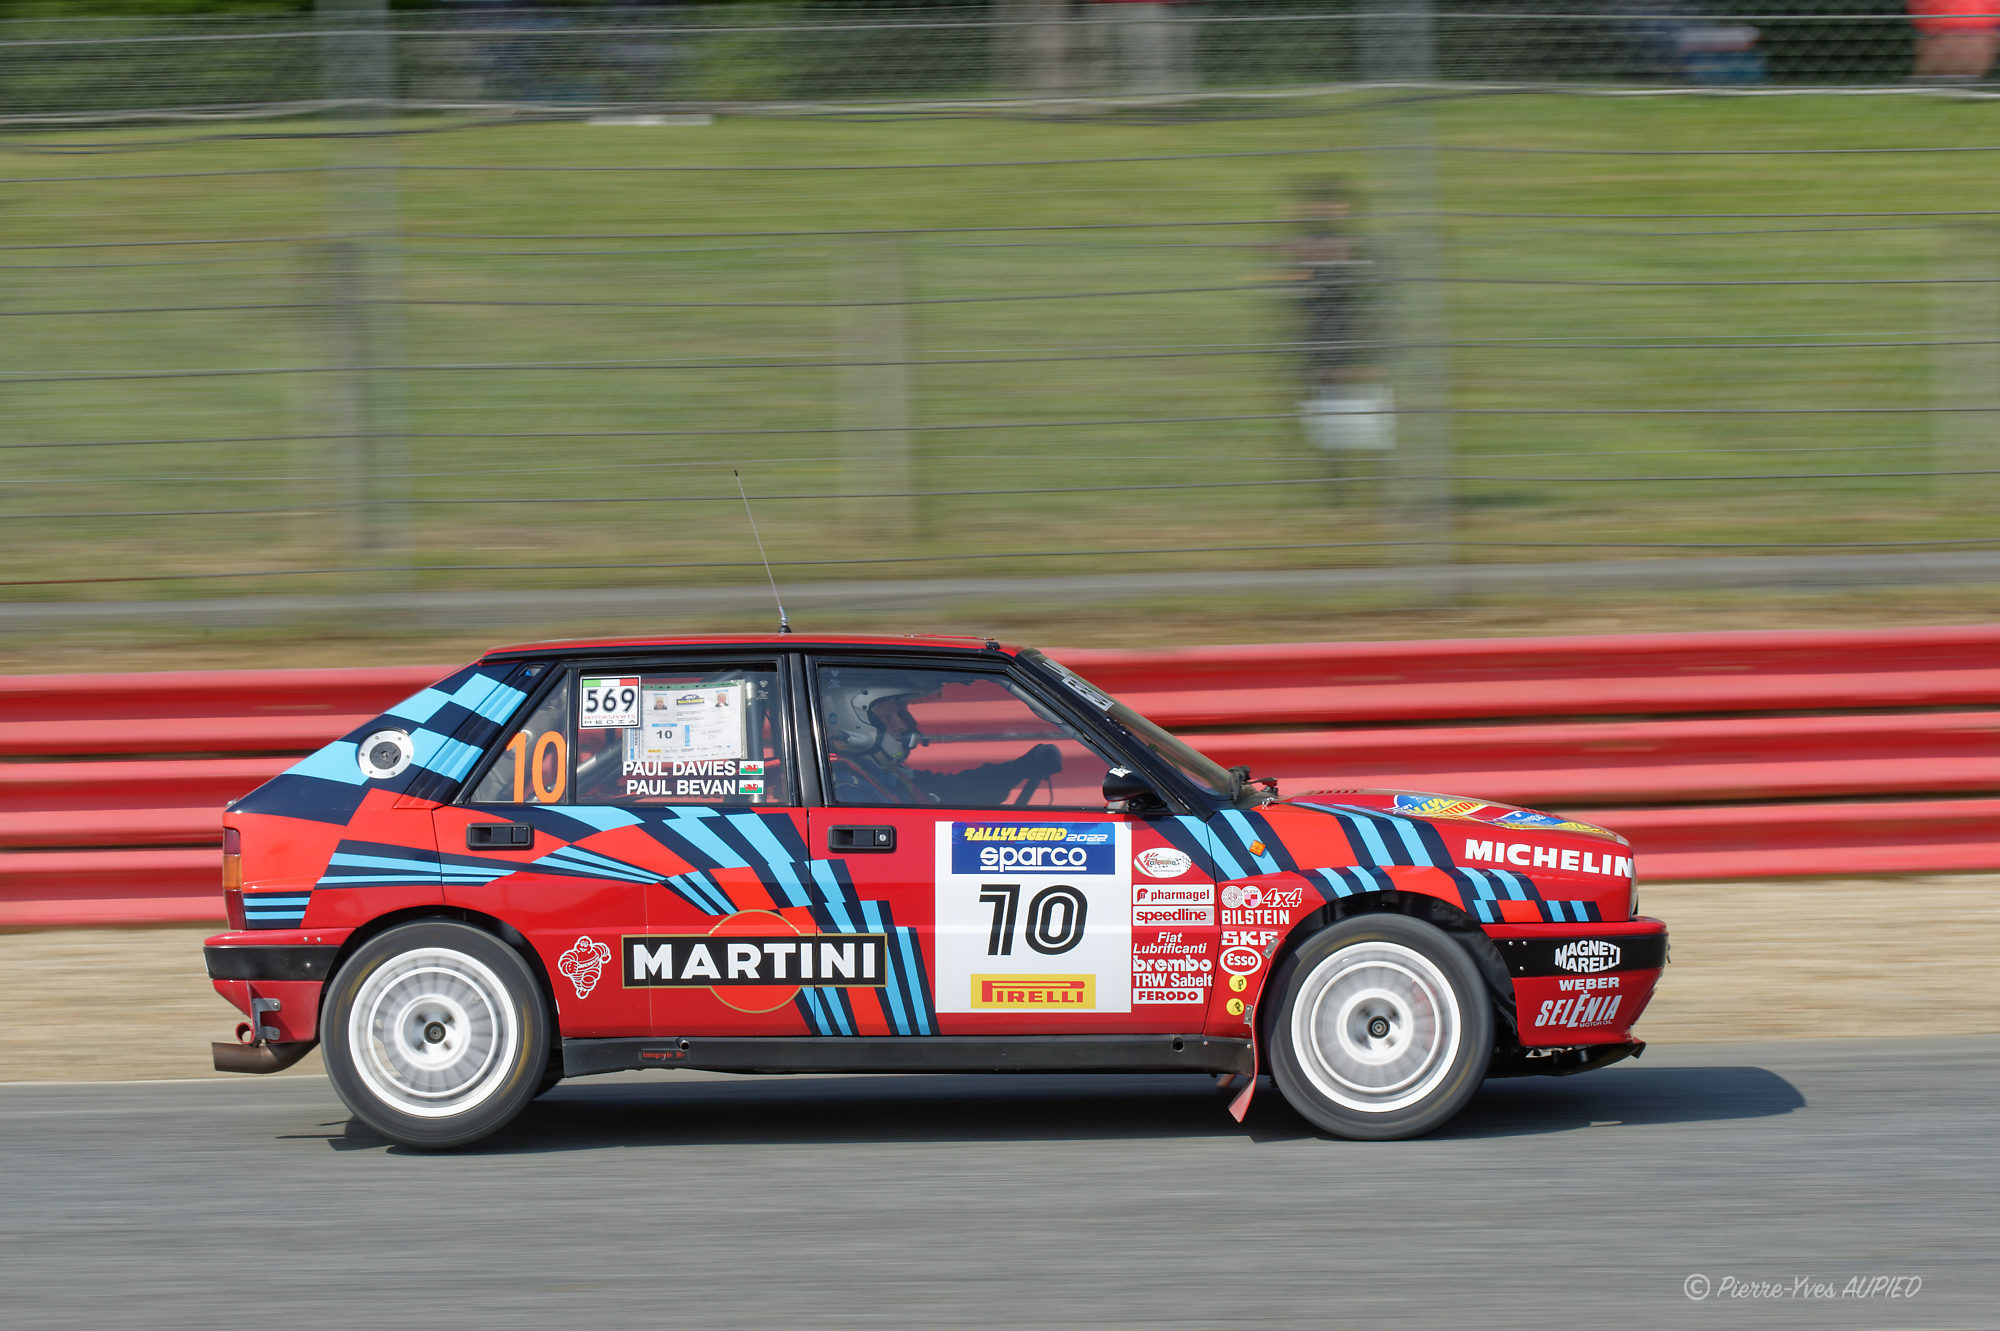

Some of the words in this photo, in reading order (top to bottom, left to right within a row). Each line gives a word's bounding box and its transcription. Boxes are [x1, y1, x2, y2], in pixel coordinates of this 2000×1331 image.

[584, 688, 636, 713] 569
[656, 730, 673, 739] 10
[506, 731, 567, 804] 10
[622, 761, 668, 776] PAUL
[672, 760, 736, 776] DAVIES
[626, 780, 672, 795] PAUL
[677, 780, 736, 795] BEVAN
[964, 827, 1068, 841] RALLYLEGEND
[1066, 834, 1109, 842] 2022
[980, 846, 1087, 872] sparco
[1465, 839, 1633, 878] MICHELIN
[1151, 889, 1210, 901] pharmagel
[1261, 888, 1302, 908] 4x4
[979, 884, 1088, 956] 10
[1136, 909, 1207, 924] speedline
[1221, 910, 1290, 925] BILSTEIN
[1157, 932, 1182, 943] Fiat
[1221, 931, 1278, 946] SKF
[1133, 942, 1207, 954] Lubrificanti
[1554, 940, 1621, 958] MAGNETI
[633, 943, 876, 980] MARTINI
[1133, 954, 1212, 972] brembo
[1226, 953, 1256, 966] Esso
[1554, 955, 1621, 973] MARELLI
[1133, 973, 1167, 987] TRW
[1170, 972, 1213, 987] Sabelt
[1559, 977, 1620, 991] WEBER
[982, 980, 1085, 1003] PIRELLI
[1138, 991, 1198, 1001] FERODO
[1579, 1020, 1602, 1028] MOTOR
